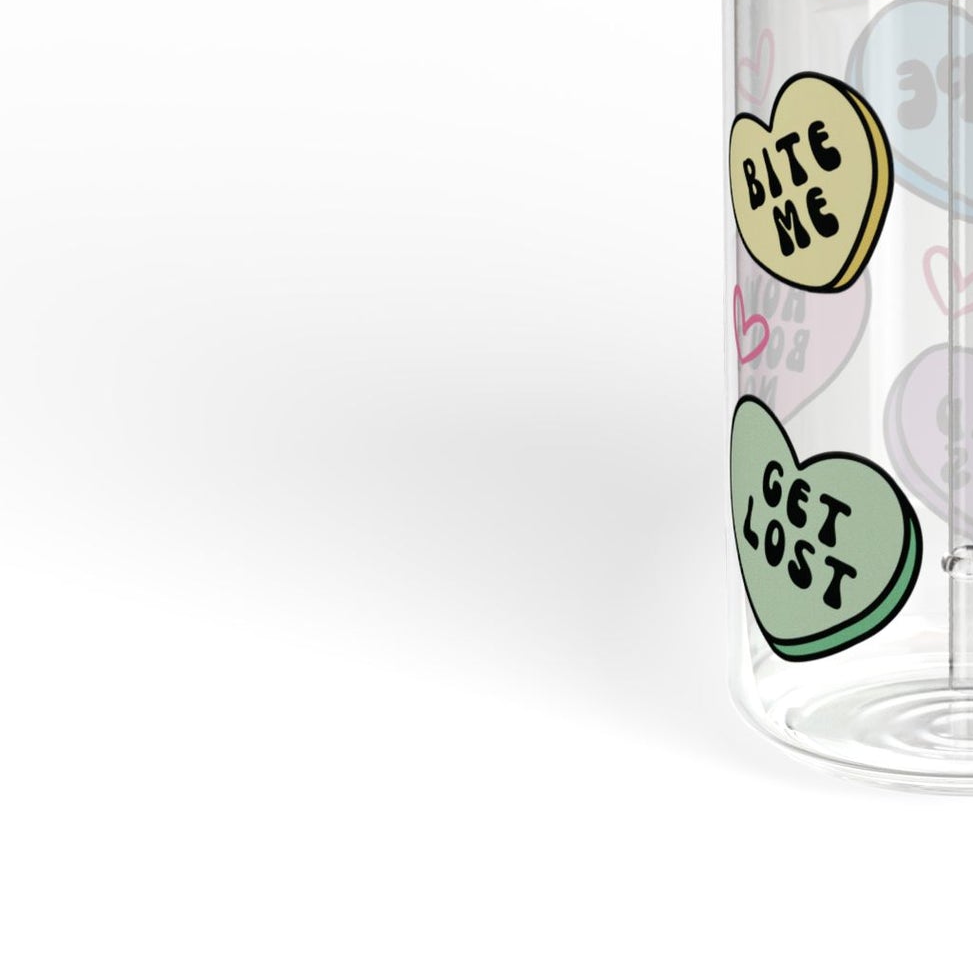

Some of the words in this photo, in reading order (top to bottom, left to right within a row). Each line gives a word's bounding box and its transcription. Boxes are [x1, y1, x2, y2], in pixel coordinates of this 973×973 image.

[742, 120, 842, 211] BITE
[772, 186, 840, 257] ME
[762, 459, 852, 548] GET
[742, 495, 858, 610] LOST
